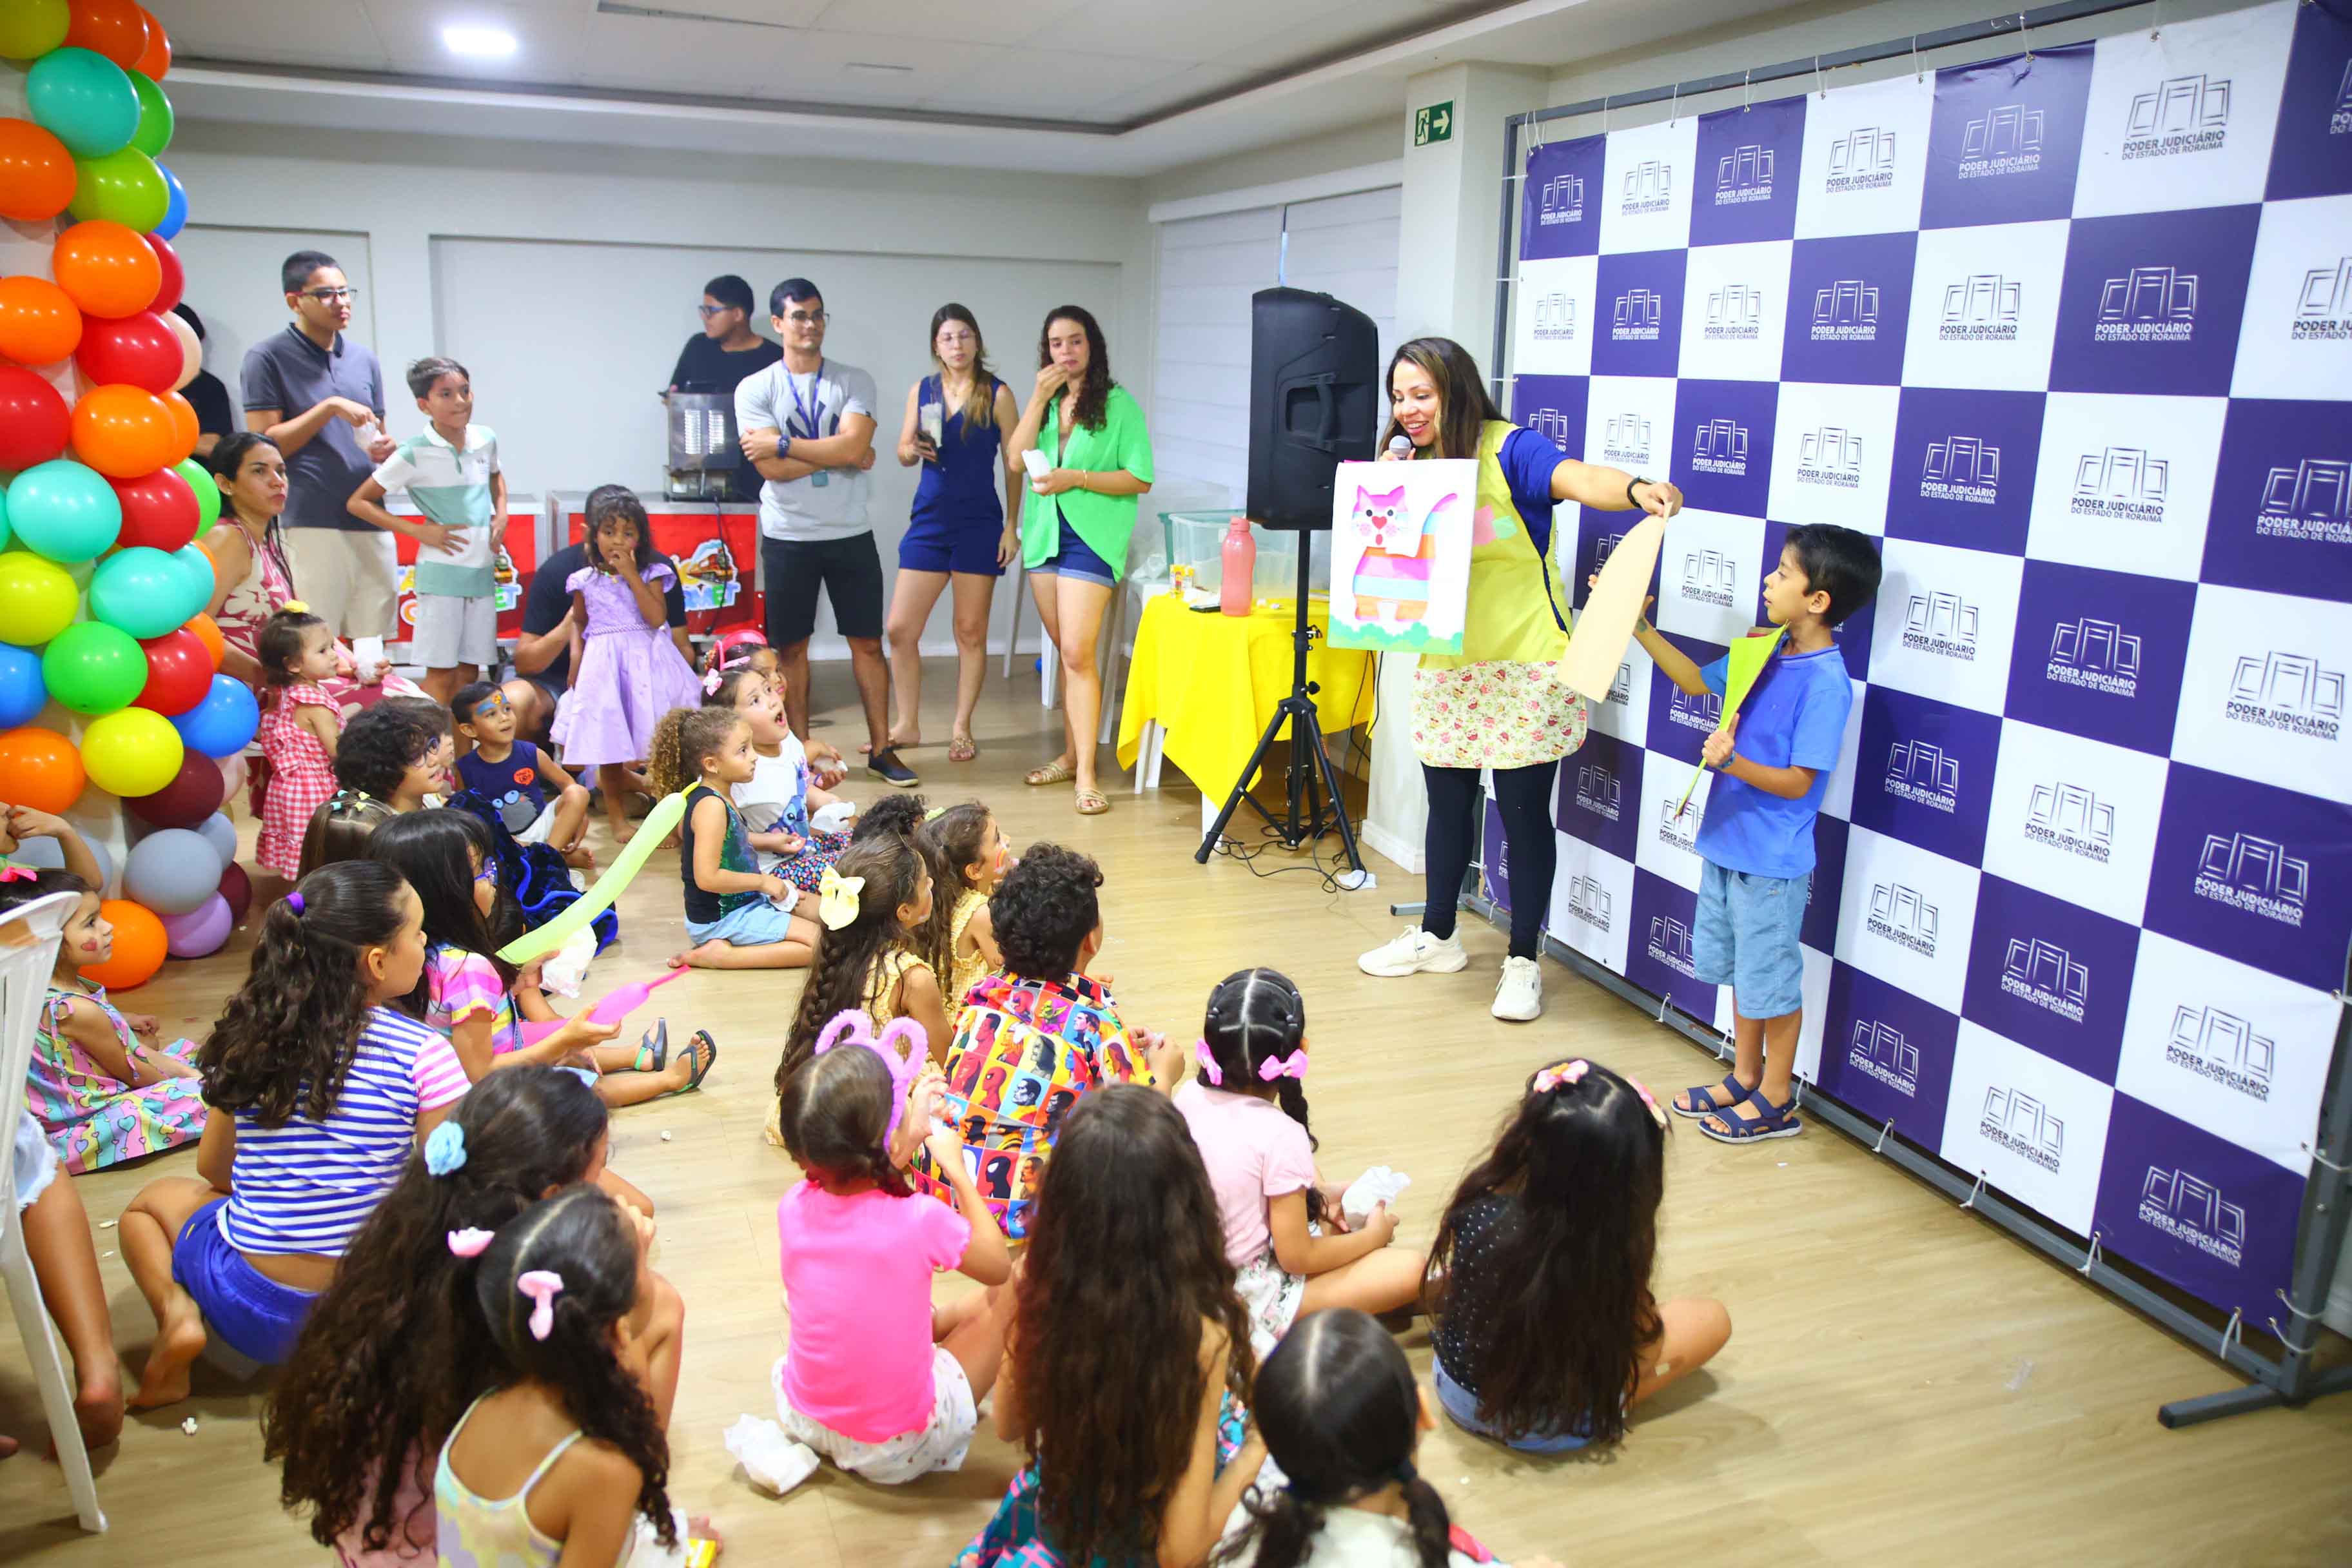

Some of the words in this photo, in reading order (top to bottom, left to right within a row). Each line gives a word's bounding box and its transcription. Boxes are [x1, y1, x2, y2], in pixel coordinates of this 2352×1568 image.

[2122, 139, 2159, 152] PODER
[2160, 130, 2226, 148] JUDICIÁRIO
[1959, 161, 1988, 172] PODER
[1988, 153, 2041, 168] JUDICIÁRIO
[2121, 152, 2133, 161] DO
[2135, 148, 2168, 159] ESTADO
[1826, 177, 1850, 186] PODER
[1969, 168, 1995, 177] ESTADO
[1716, 190, 1736, 199] PODER
[1835, 324, 1876, 333] JUDICIÁRIO
[1968, 322, 2018, 333] JUDICIÁRIO
[2095, 324, 2130, 333] PODER
[2131, 320, 2193, 333] JUDICIÁRIO
[2293, 320, 2337, 331] PODER
[1692, 458, 1712, 466] PODER
[1797, 469, 1819, 478] PODER
[1921, 482, 1948, 492] PODER
[1948, 485, 1996, 497] JUDICIÁRIO
[1930, 491, 1954, 500] ESTADO
[2071, 498, 2105, 509] PODER
[2105, 501, 2164, 515] JUDICIÁRIO
[2083, 508, 2113, 517] ESTADO
[2255, 526, 2270, 534] DO
[2271, 528, 2309, 538] ESTADO
[2257, 516, 2300, 529] PODER
[1681, 585, 1700, 595] PODER
[1903, 632, 1929, 645] PODER
[1930, 638, 1975, 655] JUDICIÁRIO
[1912, 643, 1936, 653] ESTADO
[2047, 663, 2079, 678] PODER
[2080, 670, 2137, 690] JUDICIÁRIO
[2059, 675, 2087, 687] ESTADO
[2088, 681, 2098, 689] DE
[1670, 709, 1688, 720] PODER
[2227, 711, 2240, 720] DO
[2242, 714, 2277, 728] ESTADO
[2278, 722, 2290, 731] DE
[2228, 701, 2268, 718] PODER
[2268, 709, 2338, 732] JUDICIÁRIO
[1885, 778, 1910, 792] PODER
[1910, 786, 1955, 807] JUDICIÁRIO
[1894, 789, 1916, 801] ESTADO
[2024, 823, 2056, 839] PODER
[2056, 832, 2111, 857] JUDICIÁRIO
[2024, 831, 2034, 840] DO
[2035, 835, 2063, 849] ESTADO
[2063, 844, 2073, 852] DE
[2194, 887, 2207, 896] DO
[2208, 891, 2243, 908] ESTADO
[2244, 902, 2256, 912] DE
[2195, 877, 2234, 897] PODER
[2234, 889, 2304, 919] JUDICIÁRIO
[1867, 917, 1892, 934] PODER
[1892, 928, 1936, 952] JUDICIÁRIO
[1867, 925, 1875, 933] DO
[1876, 929, 1897, 943] ESTADO
[1898, 938, 1906, 946] DE
[2001, 975, 2032, 994] PODER
[2032, 988, 2084, 1016] JUDICIÁRIO
[2001, 983, 2011, 992] DO
[2012, 988, 2039, 1004] ESTADO
[2039, 999, 2048, 1008] DE
[1849, 1059, 1857, 1067] DO
[1858, 1063, 1879, 1079] ESTADO
[1879, 1075, 1887, 1083] DE
[1850, 1052, 1874, 1070] PODER
[1874, 1064, 1916, 1092] JUDICIÁRIO
[2165, 1054, 2178, 1064] DO
[2179, 1059, 2212, 1079] ESTADO
[2213, 1073, 2225, 1084] DE
[2166, 1044, 2204, 1068] PODER
[2204, 1061, 2270, 1095] JUDICIÁRIO
[1979, 1128, 1989, 1138] DO
[1990, 1134, 2015, 1152] ESTADO
[2016, 1148, 2025, 1157] DE
[1980, 1121, 2009, 1142] PODER
[2009, 1135, 2060, 1168] JUDICIÁRIO
[2139, 1203, 2176, 1228] PODER
[2177, 1222, 2241, 1260] JUDICIÁRIO
